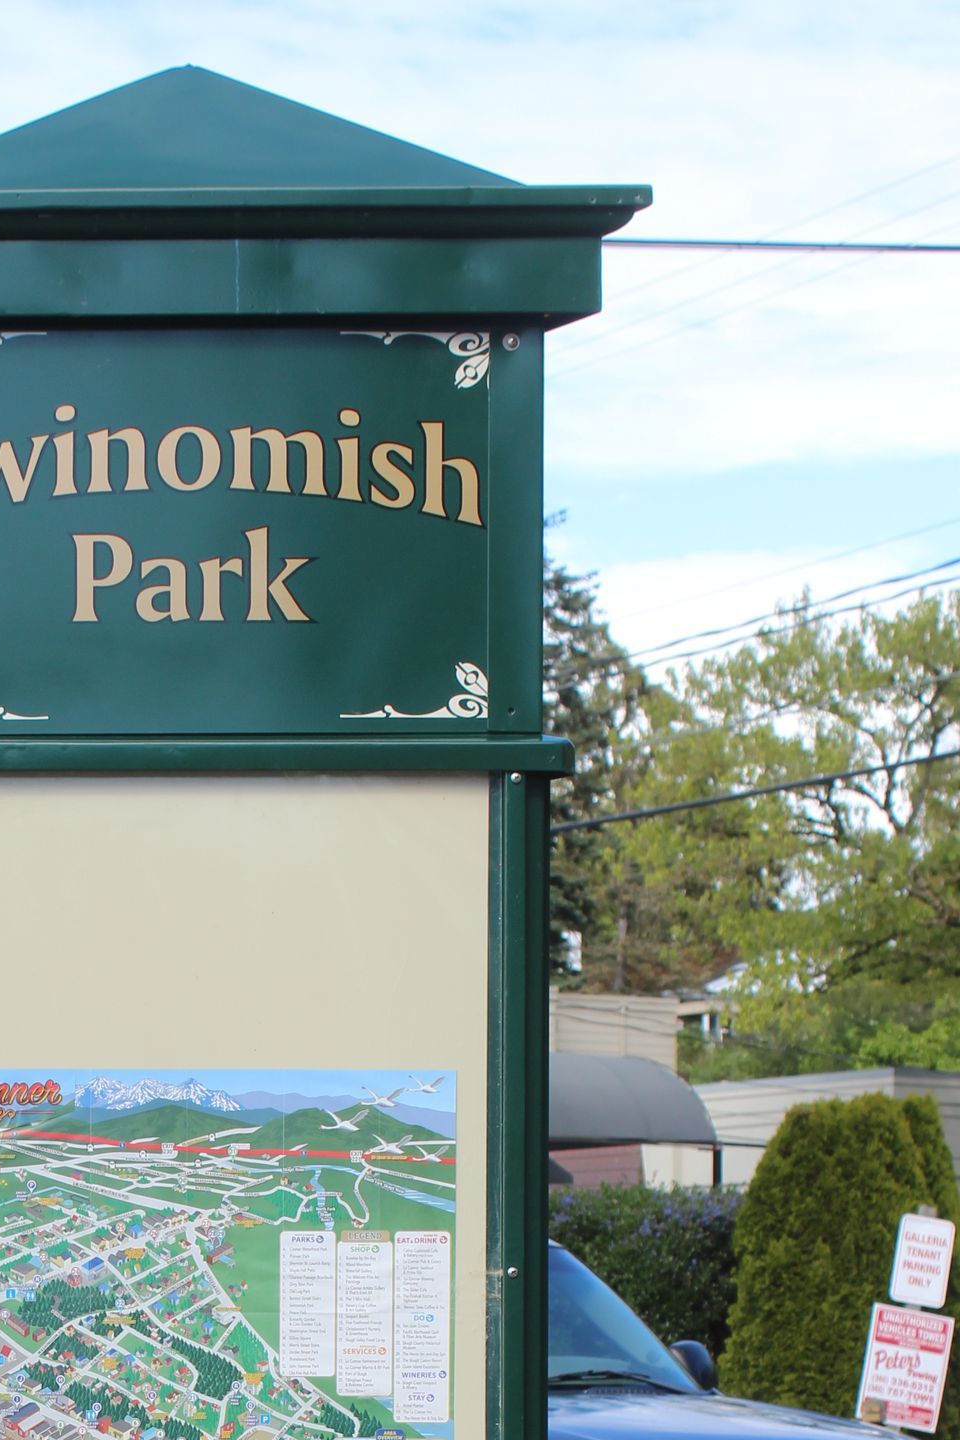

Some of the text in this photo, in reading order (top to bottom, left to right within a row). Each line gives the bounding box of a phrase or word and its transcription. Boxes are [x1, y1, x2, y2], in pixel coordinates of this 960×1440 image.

[71, 526, 316, 623] Park
[905, 1231, 948, 1247] GALLERIA
[908, 1246, 942, 1259] TENANT
[903, 1260, 941, 1275] PARKING
[908, 1275, 932, 1288] ONLY
[884, 1312, 944, 1331] UNAUTHORIZED
[879, 1323, 945, 1343] VEHICLES TOWED
